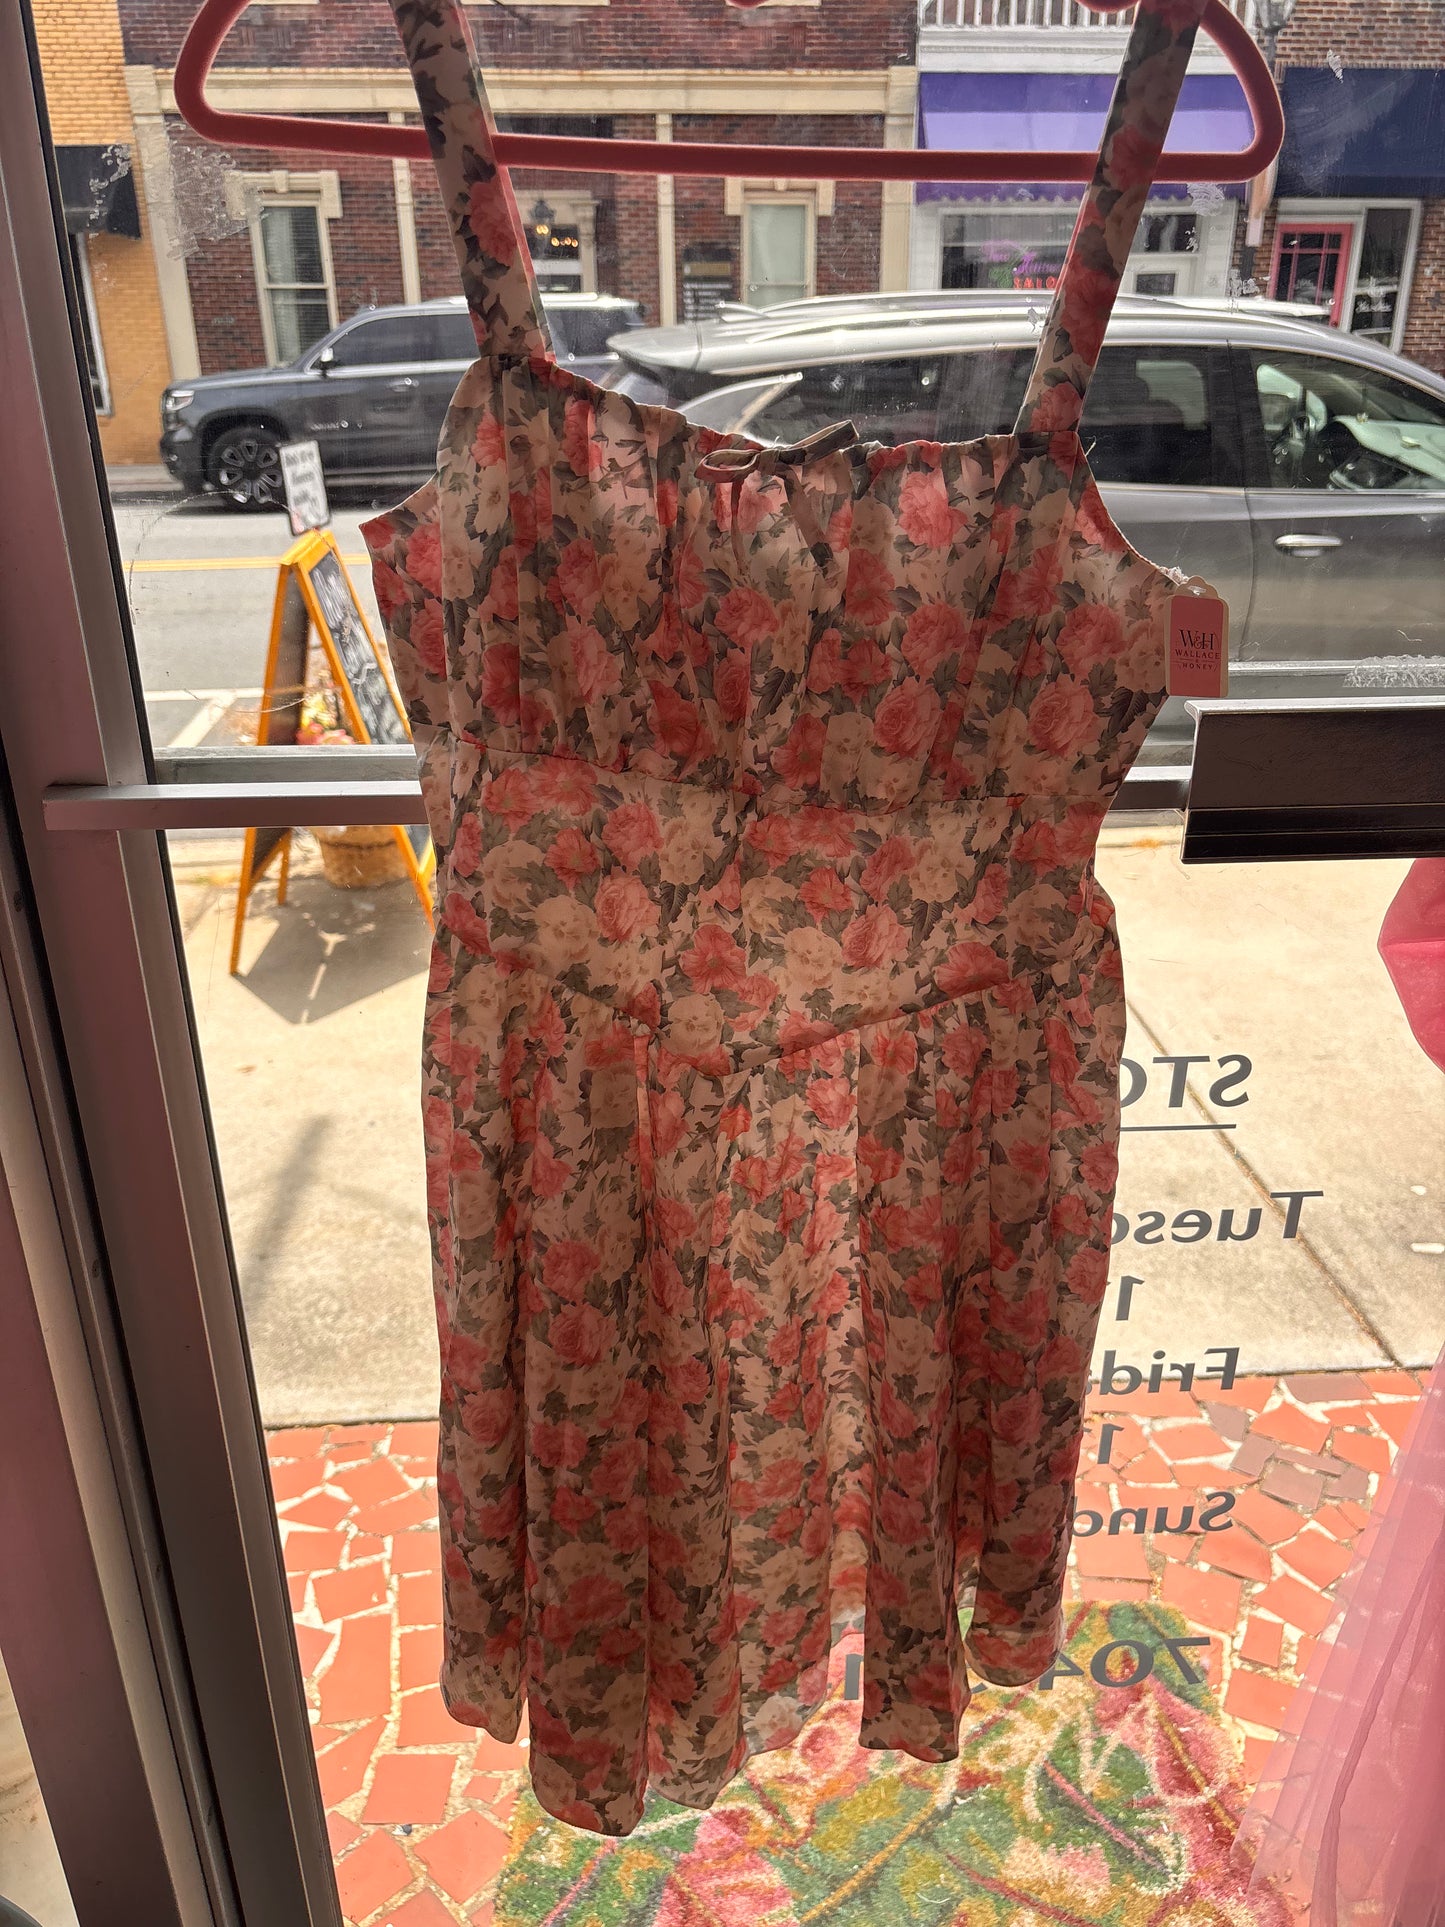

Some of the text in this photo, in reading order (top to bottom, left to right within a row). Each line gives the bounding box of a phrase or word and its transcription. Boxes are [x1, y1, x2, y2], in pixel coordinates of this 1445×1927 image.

[1178, 629, 1214, 650] W&H
[1175, 649, 1221, 659] WALLACE
[1182, 662, 1213, 670] HONEY
